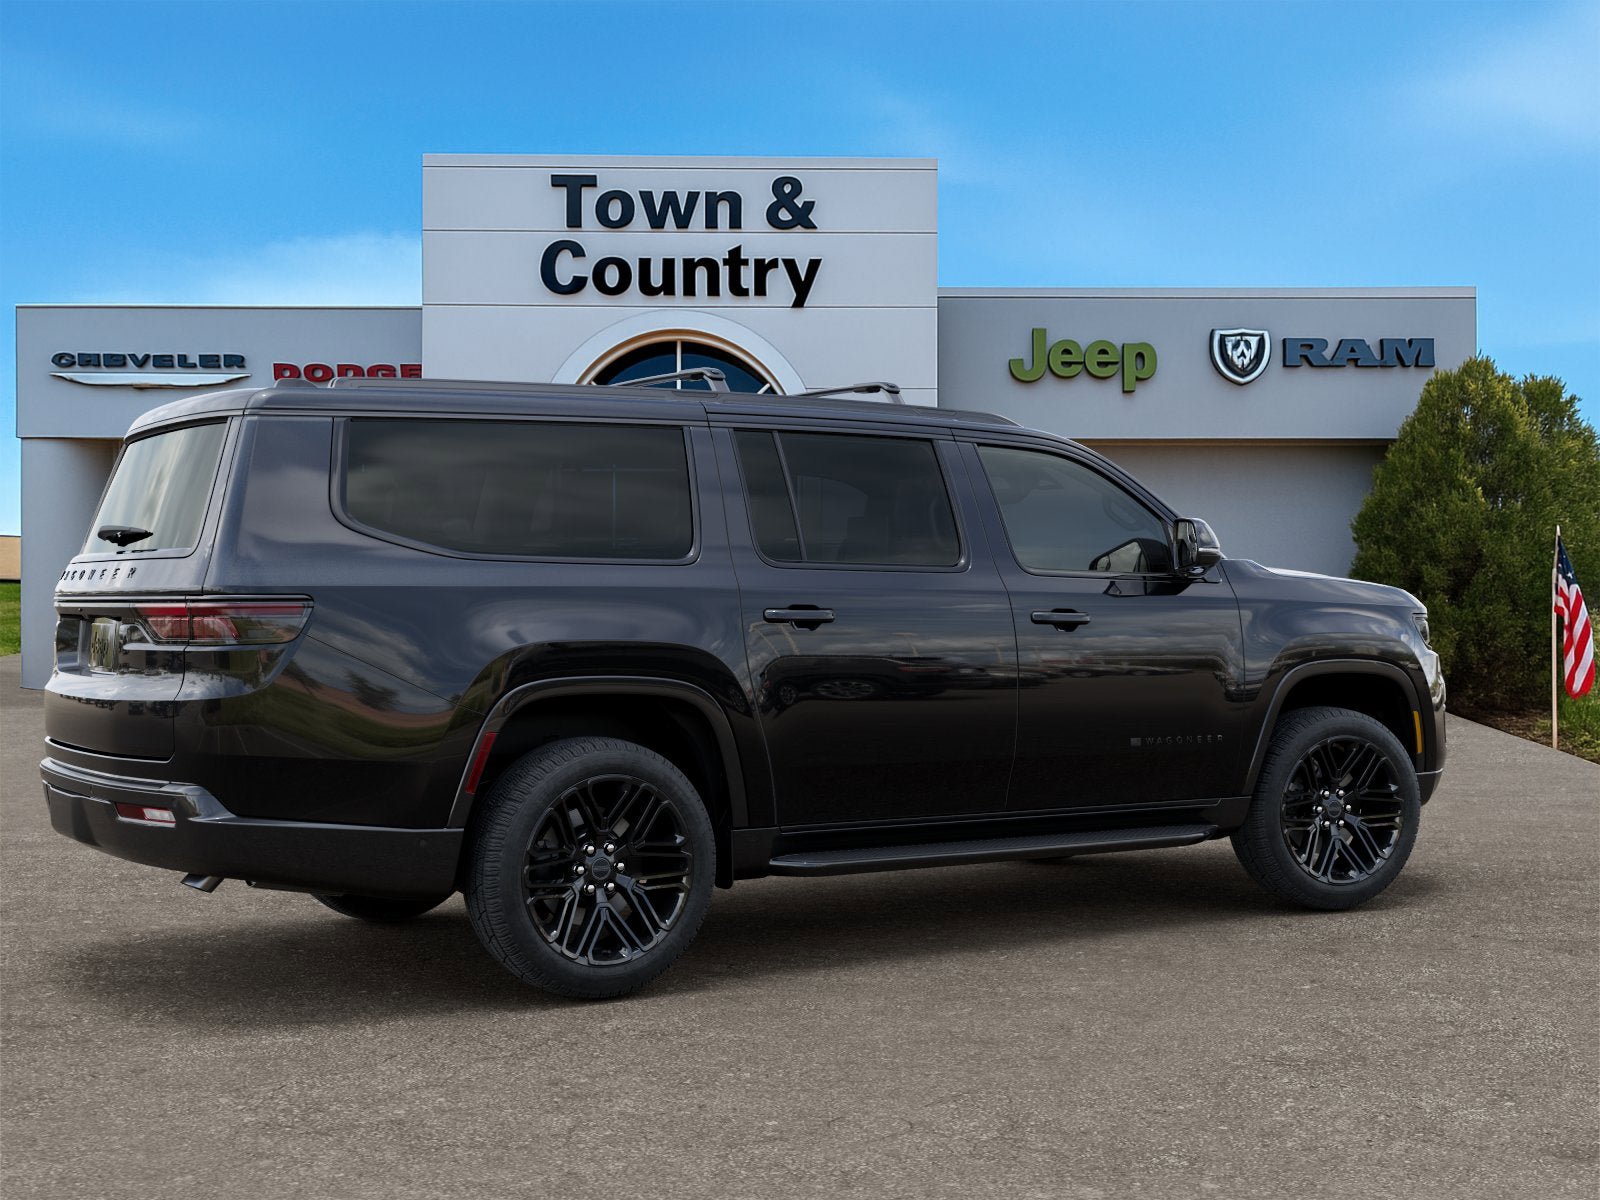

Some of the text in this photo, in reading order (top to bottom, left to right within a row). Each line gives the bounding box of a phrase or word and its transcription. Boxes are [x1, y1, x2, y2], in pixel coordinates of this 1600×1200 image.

[550, 174, 818, 230] Town &
[540, 239, 822, 308] Country
[273, 363, 422, 382] DODGE
[1008, 327, 1157, 393] Jeep
[1282, 337, 1435, 368] RAM
[1145, 734, 1224, 745] WAGONEER
